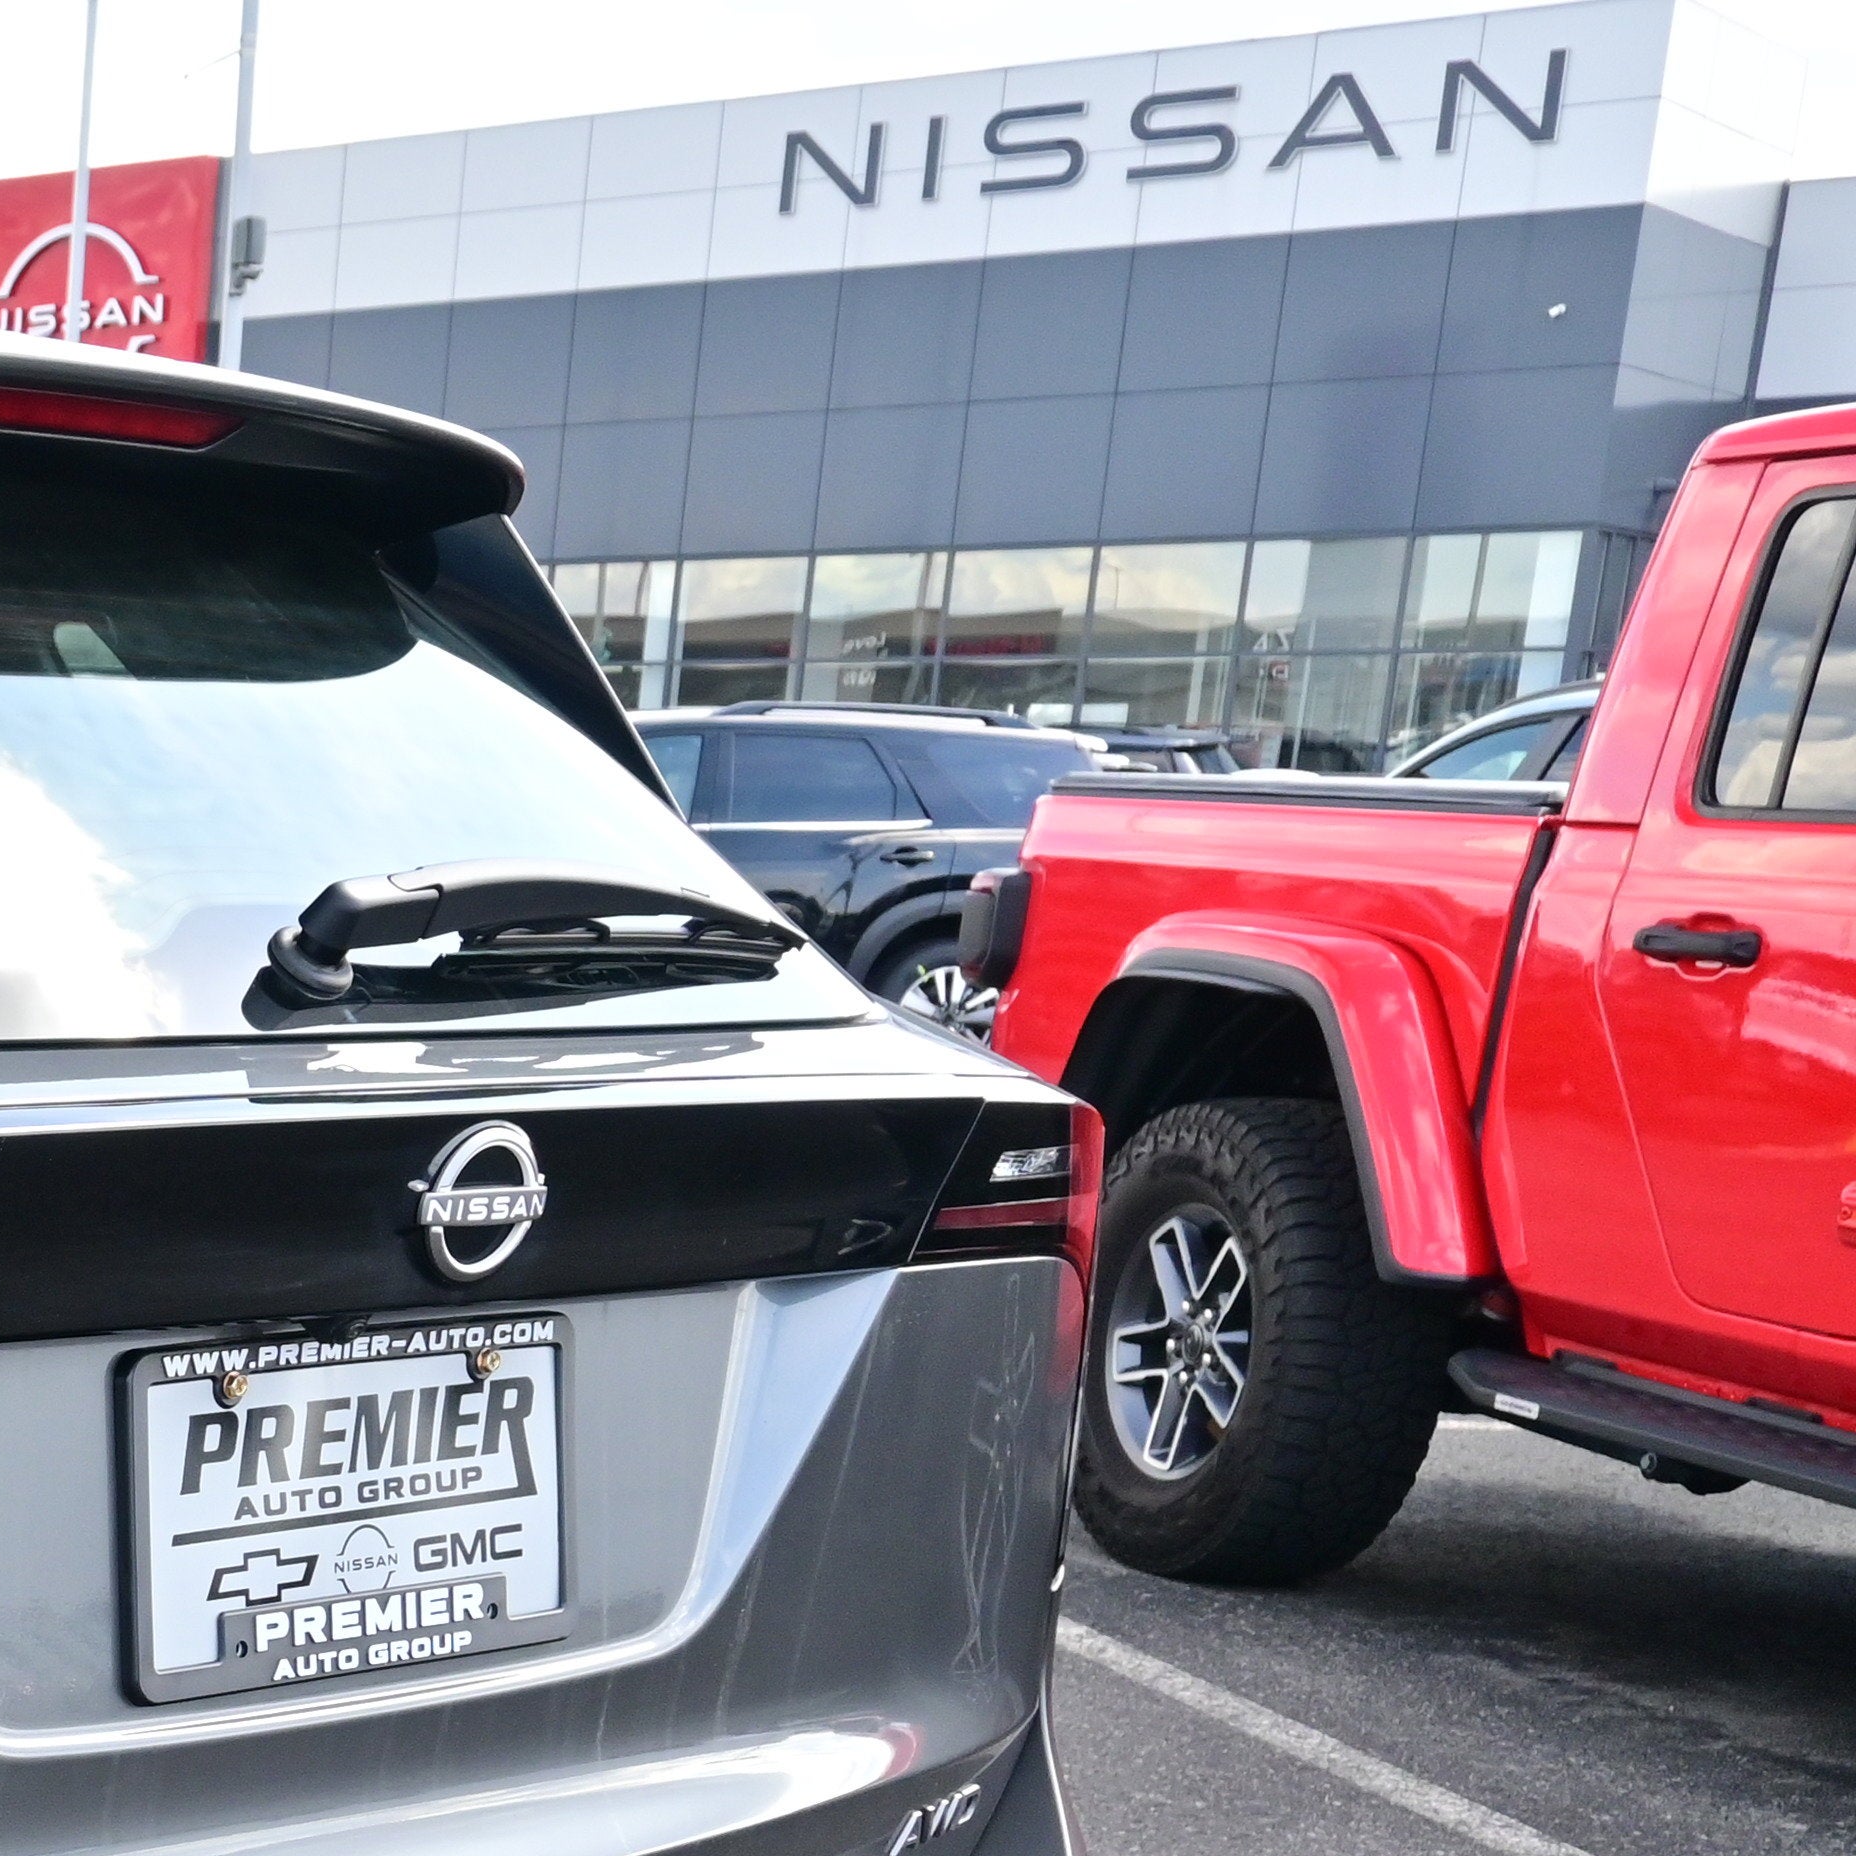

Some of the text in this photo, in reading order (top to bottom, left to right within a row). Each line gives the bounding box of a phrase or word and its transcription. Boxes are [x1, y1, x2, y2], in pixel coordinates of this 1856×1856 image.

[779, 47, 1570, 215] NISSAN
[426, 1193, 546, 1222] NISSAN
[162, 1320, 555, 1378] WWW.PREMIER-AUTO.COM
[179, 1376, 538, 1497] PREMIER
[233, 1465, 483, 1521] AUTO GROUP
[334, 1523, 524, 1574] NISSAN GMC
[254, 1582, 485, 1654] PREMIER
[272, 1630, 473, 1682] AUTO GROUP
